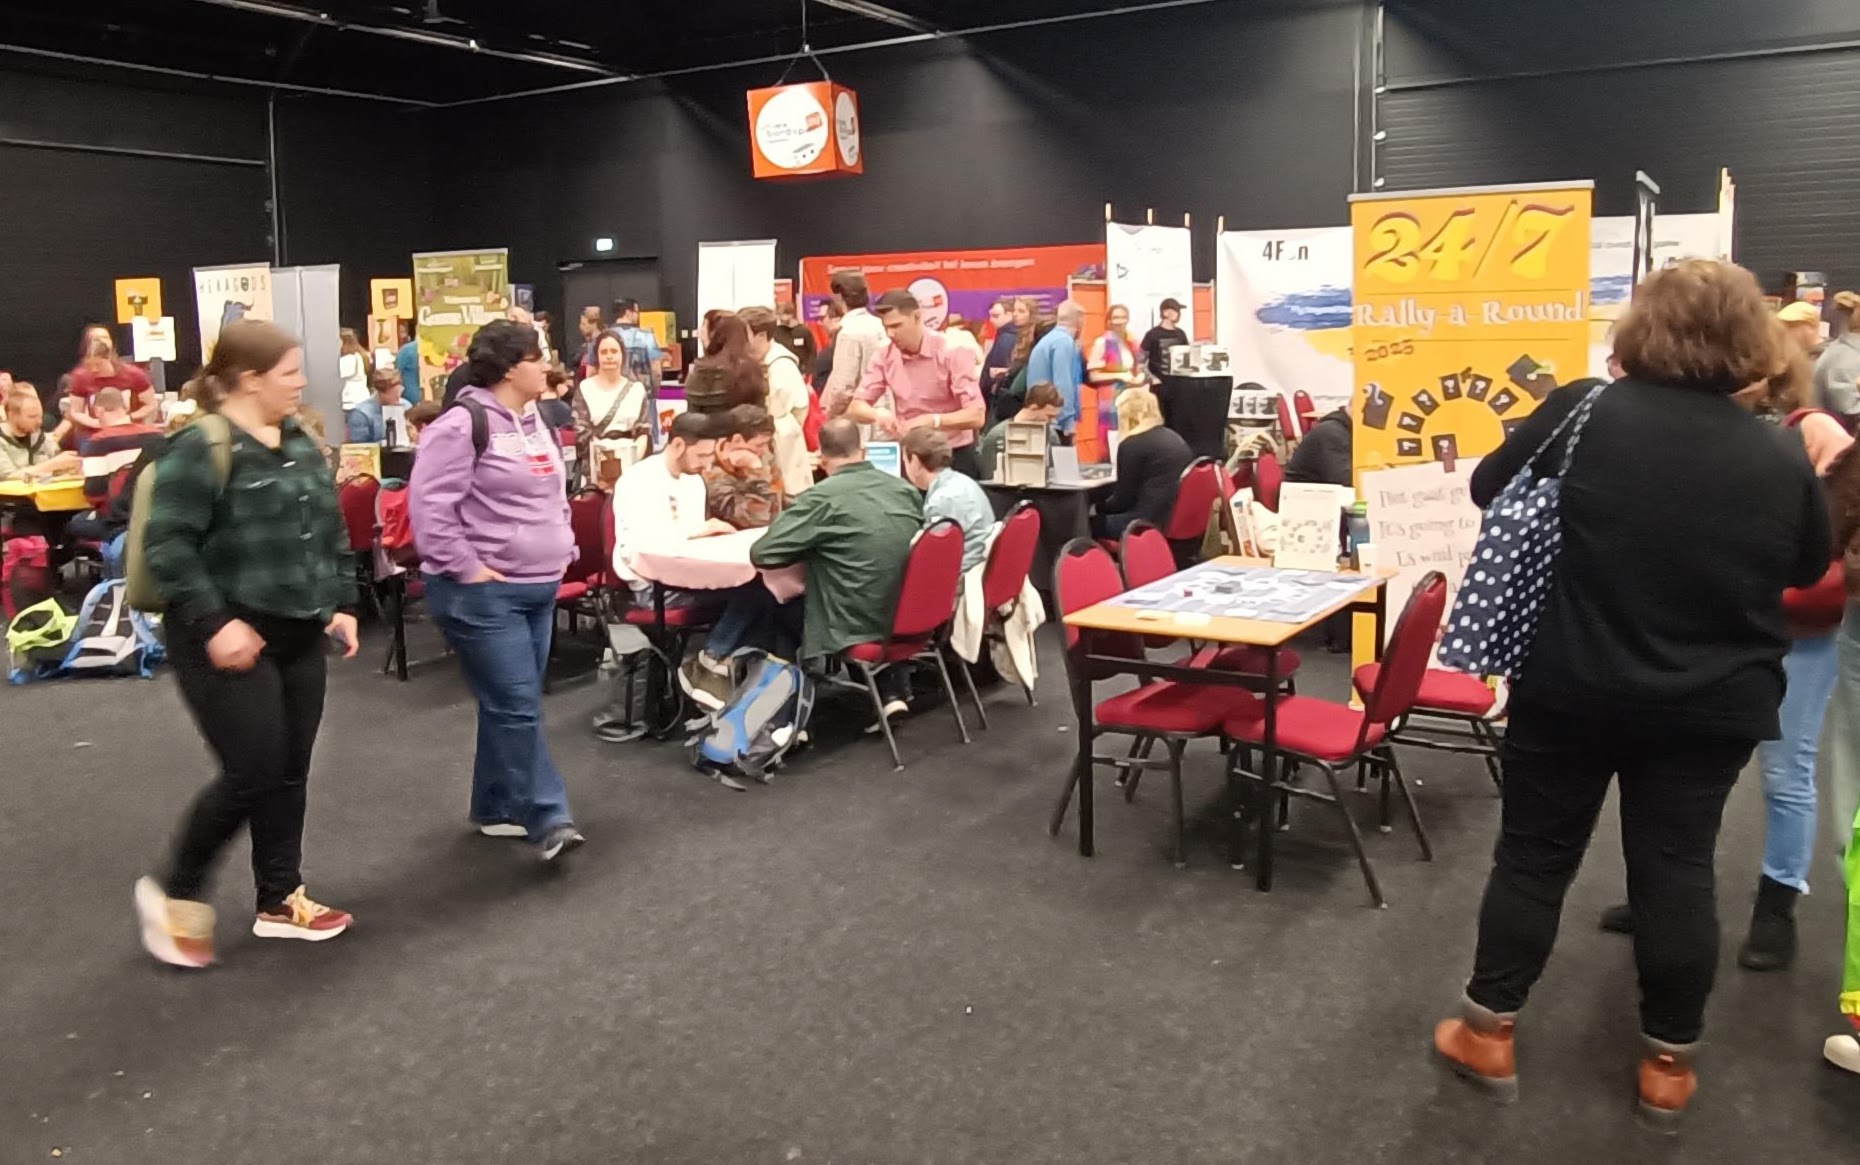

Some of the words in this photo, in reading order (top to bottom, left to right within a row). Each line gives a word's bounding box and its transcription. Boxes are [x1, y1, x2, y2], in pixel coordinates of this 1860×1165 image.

[1262, 240, 1309, 261] 4Fn
[1363, 198, 1575, 283] 24/7
[1353, 298, 1437, 335] Rally
[1447, 302, 1467, 327] a
[1482, 290, 1587, 326] Round
[1364, 338, 1414, 362] 2025
